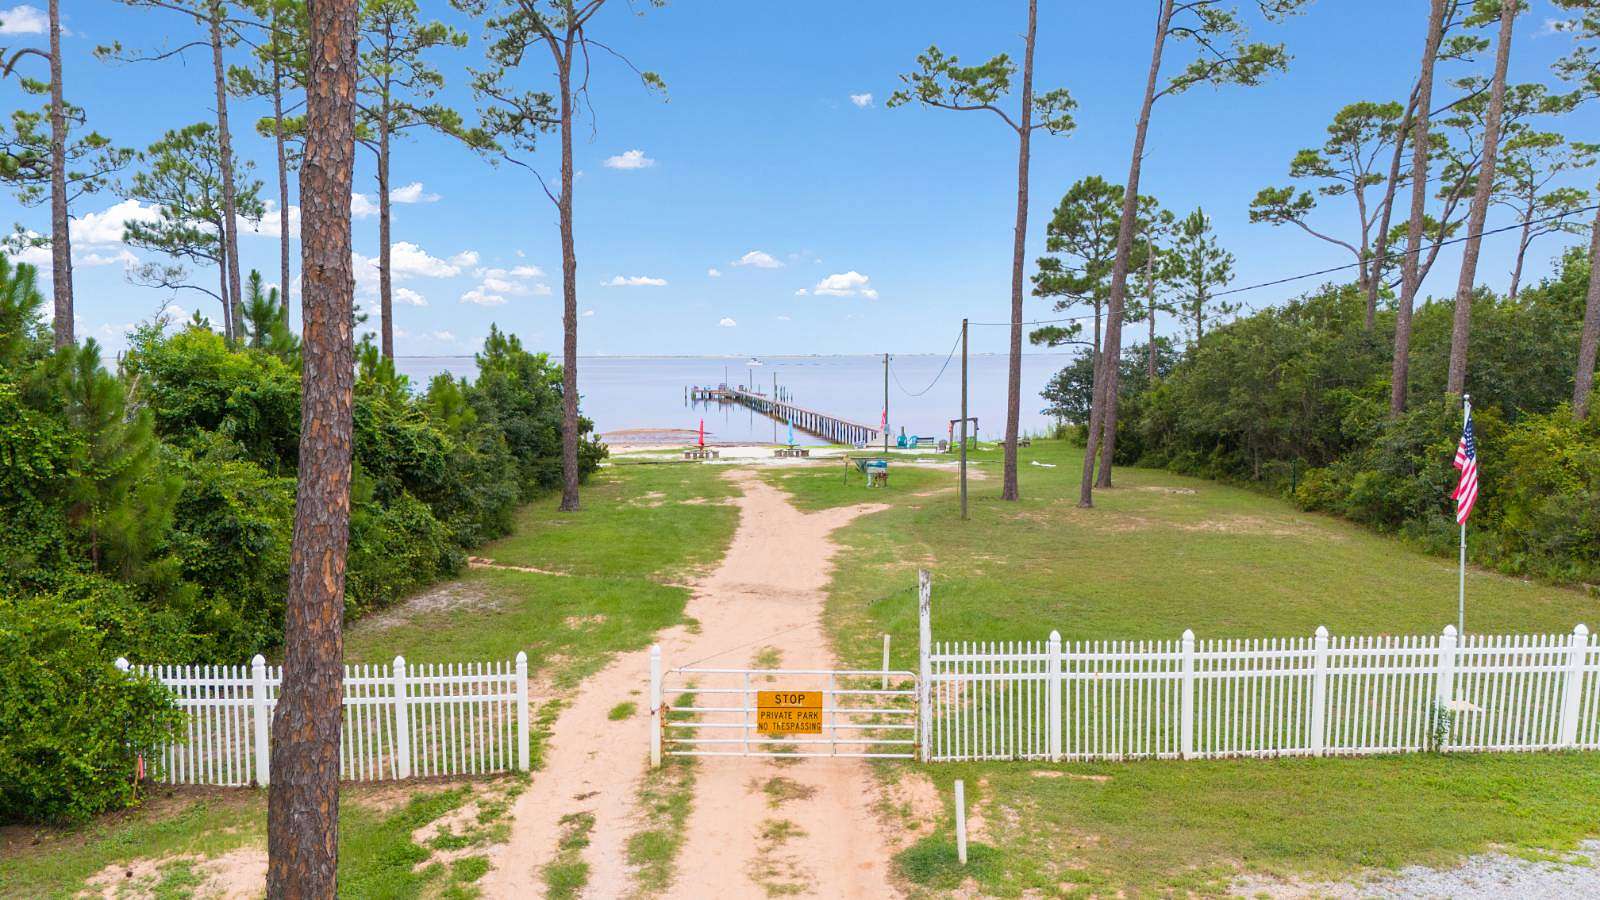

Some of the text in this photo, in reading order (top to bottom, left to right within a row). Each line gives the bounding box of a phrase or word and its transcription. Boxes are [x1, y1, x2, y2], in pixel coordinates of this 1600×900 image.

[775, 694, 805, 704] STOP
[760, 711, 818, 719] PRIVATE PARK
[757, 722, 768, 731] NO
